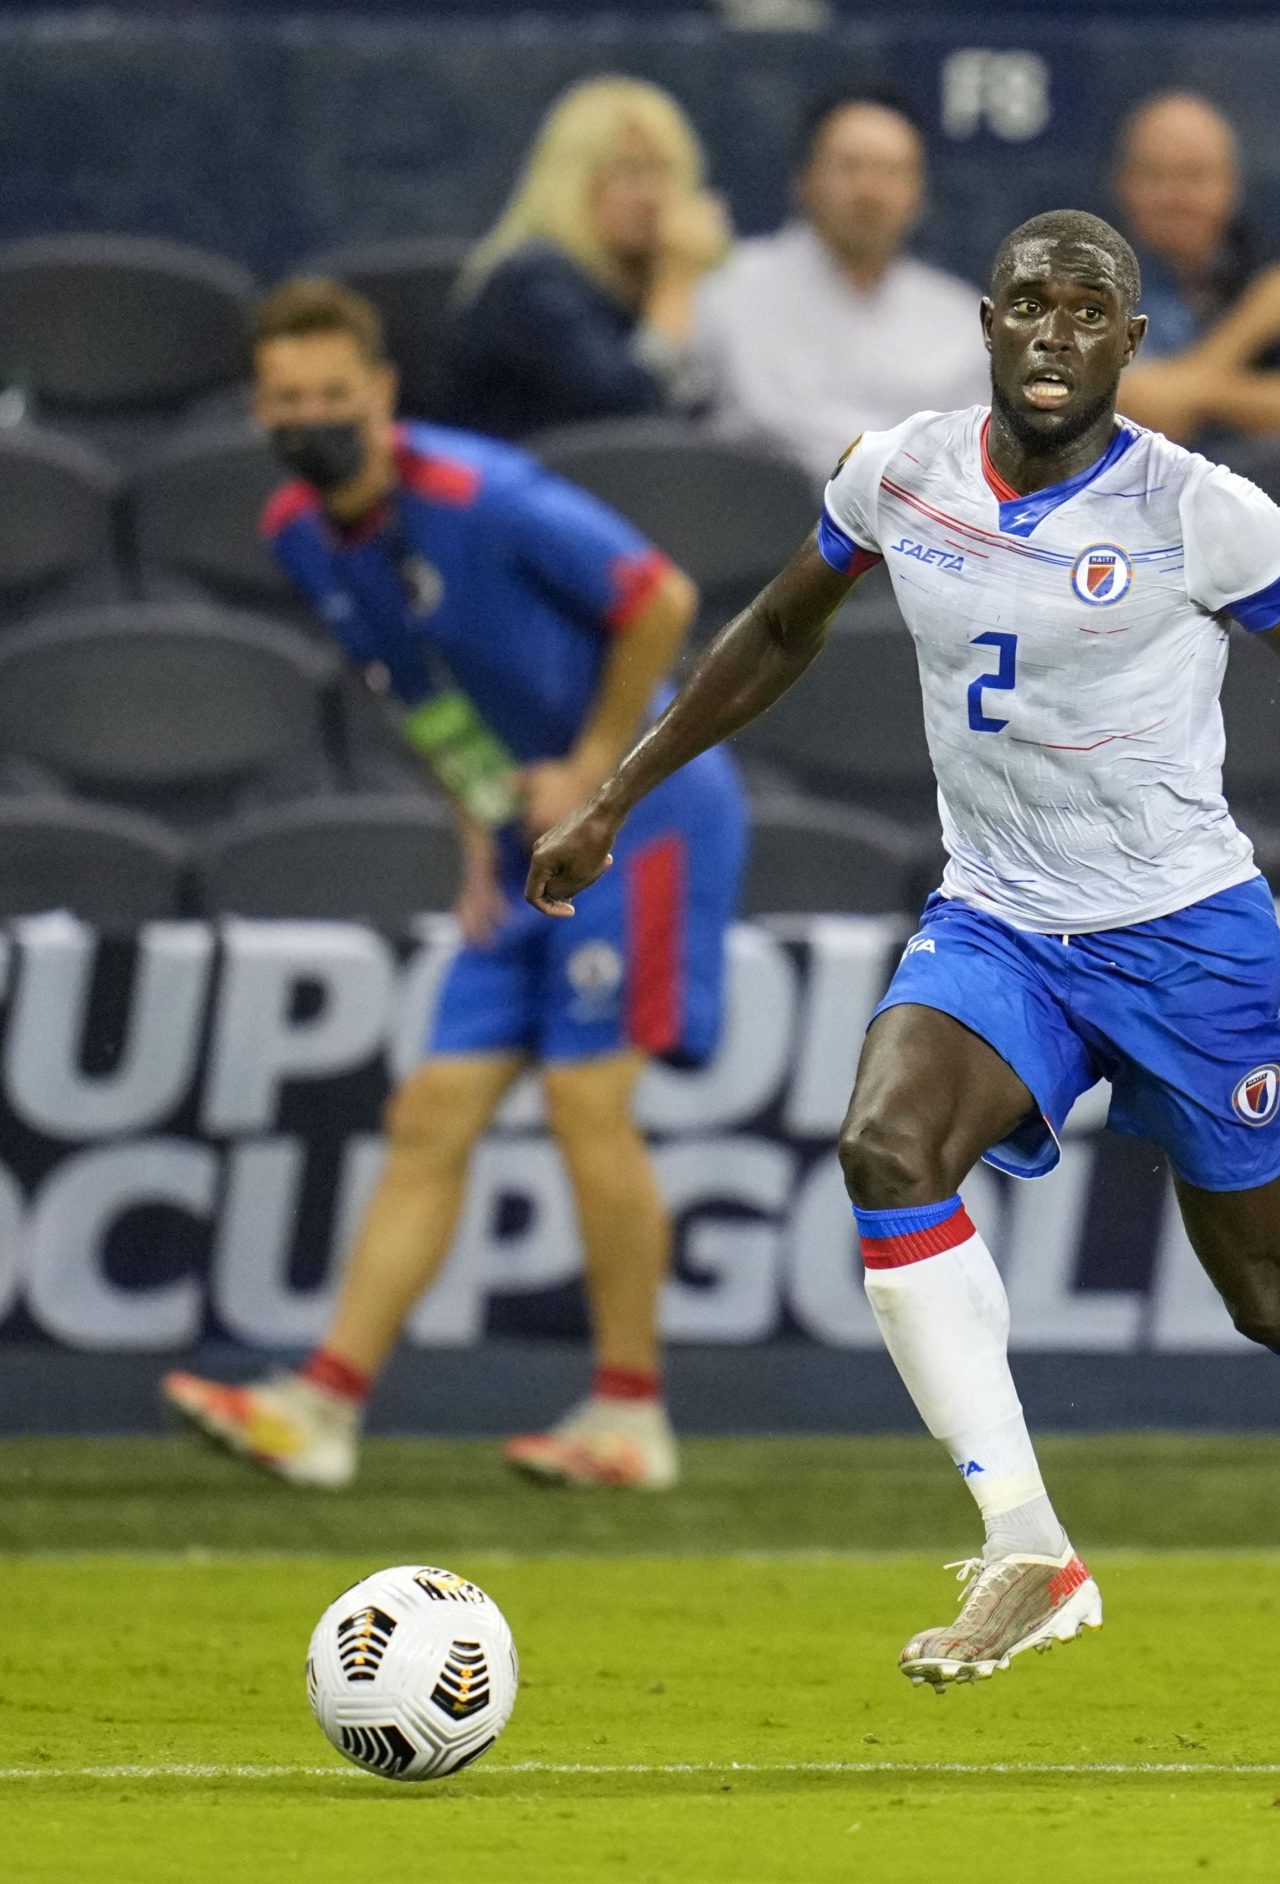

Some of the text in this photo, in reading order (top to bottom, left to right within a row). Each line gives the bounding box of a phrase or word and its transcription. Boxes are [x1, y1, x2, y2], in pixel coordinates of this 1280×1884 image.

[890, 538, 965, 571] SAETA
[1090, 556, 1114, 564] HAITI
[968, 631, 1018, 733] 2
[0, 905, 398, 1142] UP
